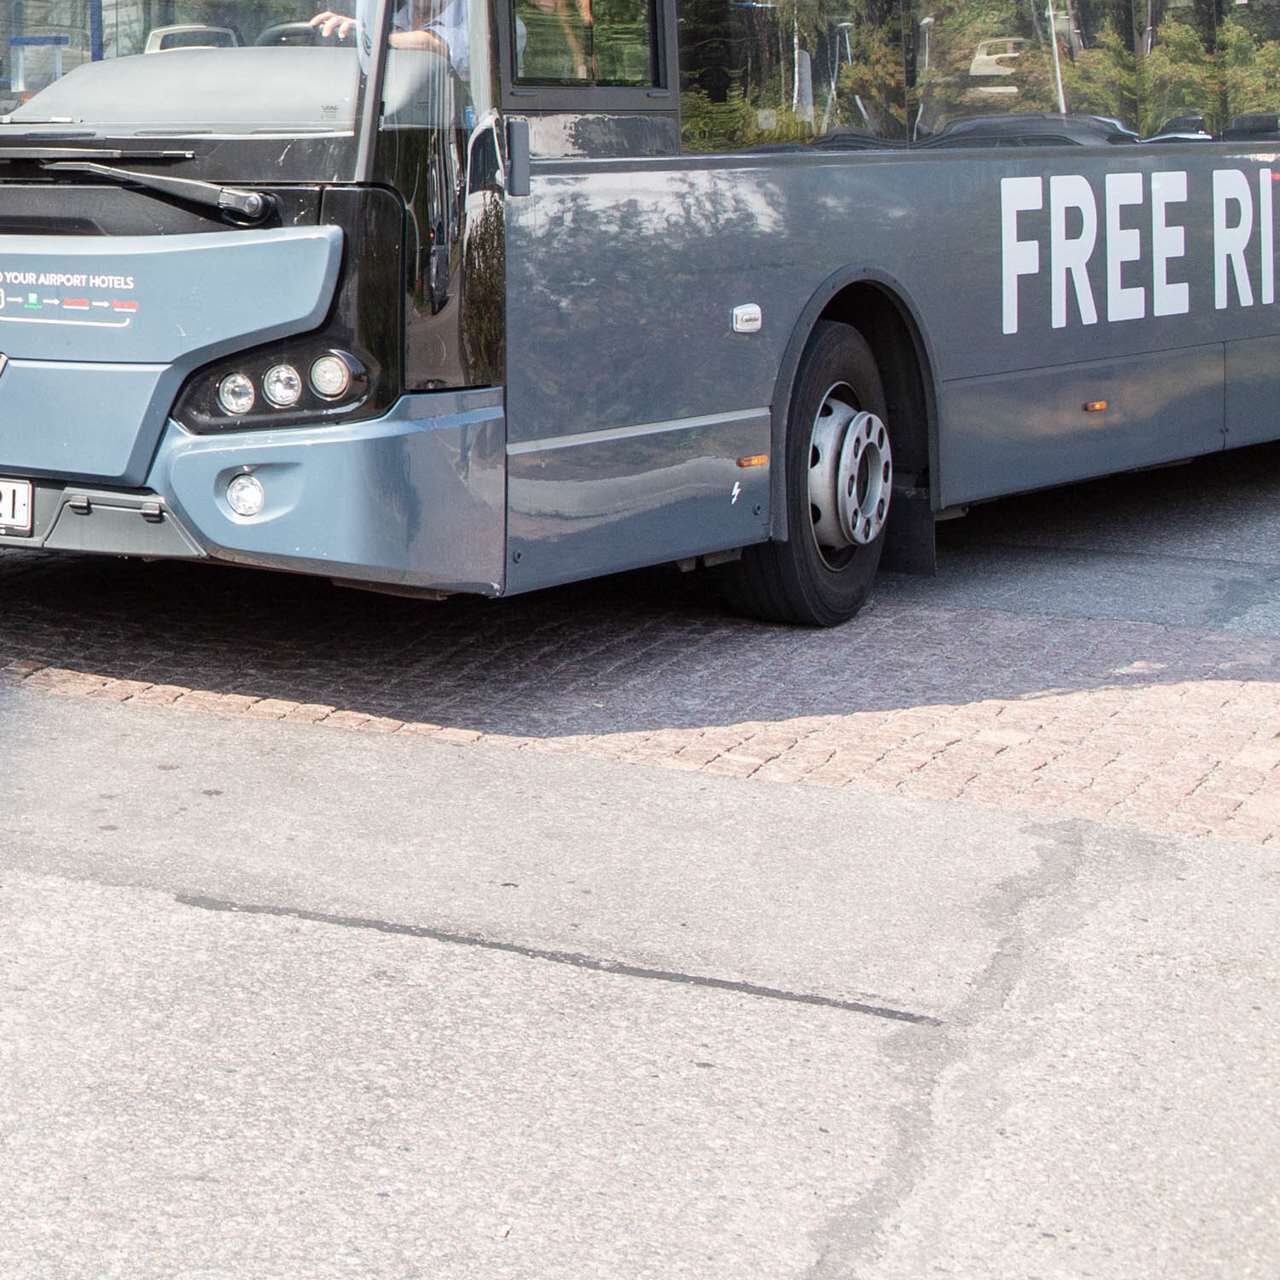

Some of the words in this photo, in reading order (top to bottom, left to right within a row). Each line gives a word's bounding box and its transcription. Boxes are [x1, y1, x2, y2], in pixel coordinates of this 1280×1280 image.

[5, 272, 37, 285] YOUR
[38, 273, 88, 287] AIRPORT
[89, 276, 134, 289] HOTELS
[1001, 171, 1190, 335] FREE
